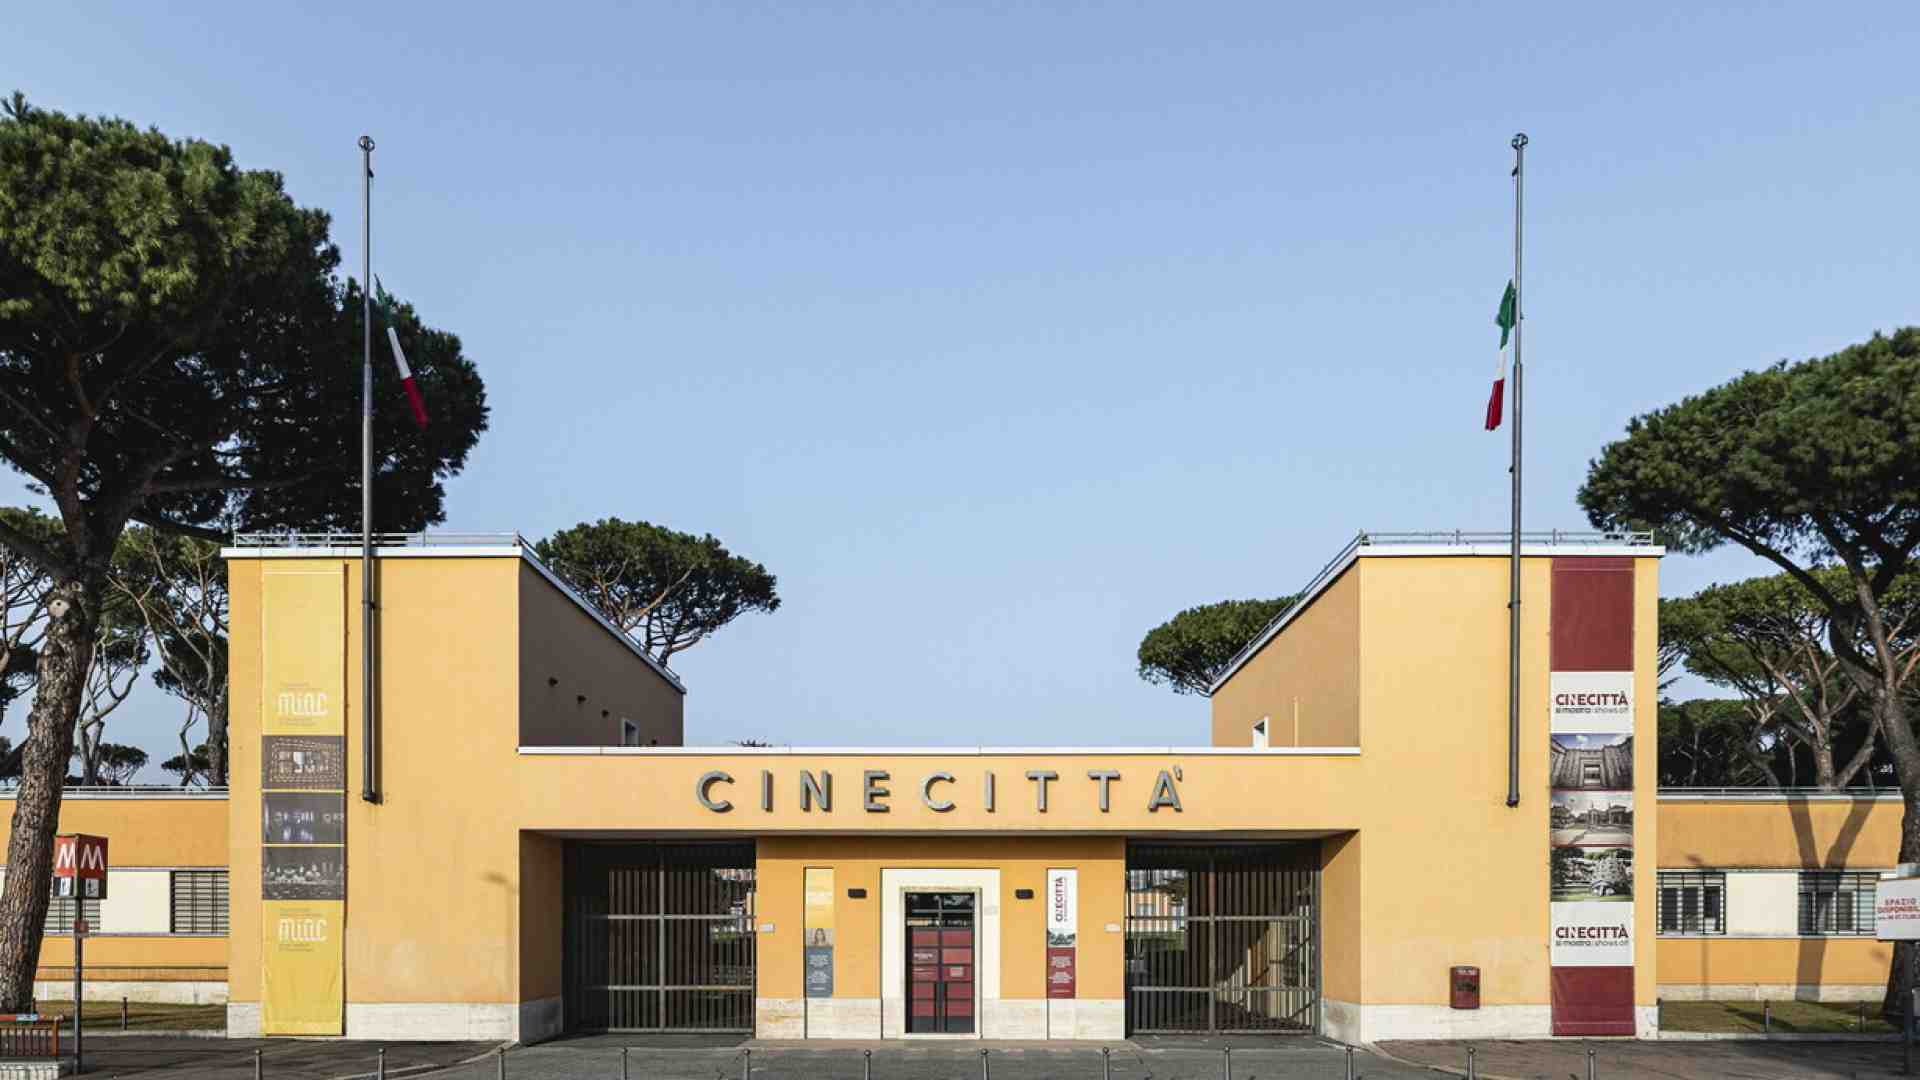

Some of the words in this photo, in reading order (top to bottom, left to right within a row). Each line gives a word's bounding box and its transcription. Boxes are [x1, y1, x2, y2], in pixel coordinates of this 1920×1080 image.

[1555, 690, 1629, 705] CINECITTÀ
[695, 764, 1184, 812] CINECITTÀ
[56, 842, 76, 869] M
[80, 843, 105, 870] M
[1555, 923, 1629, 938] CINECITTÀ
